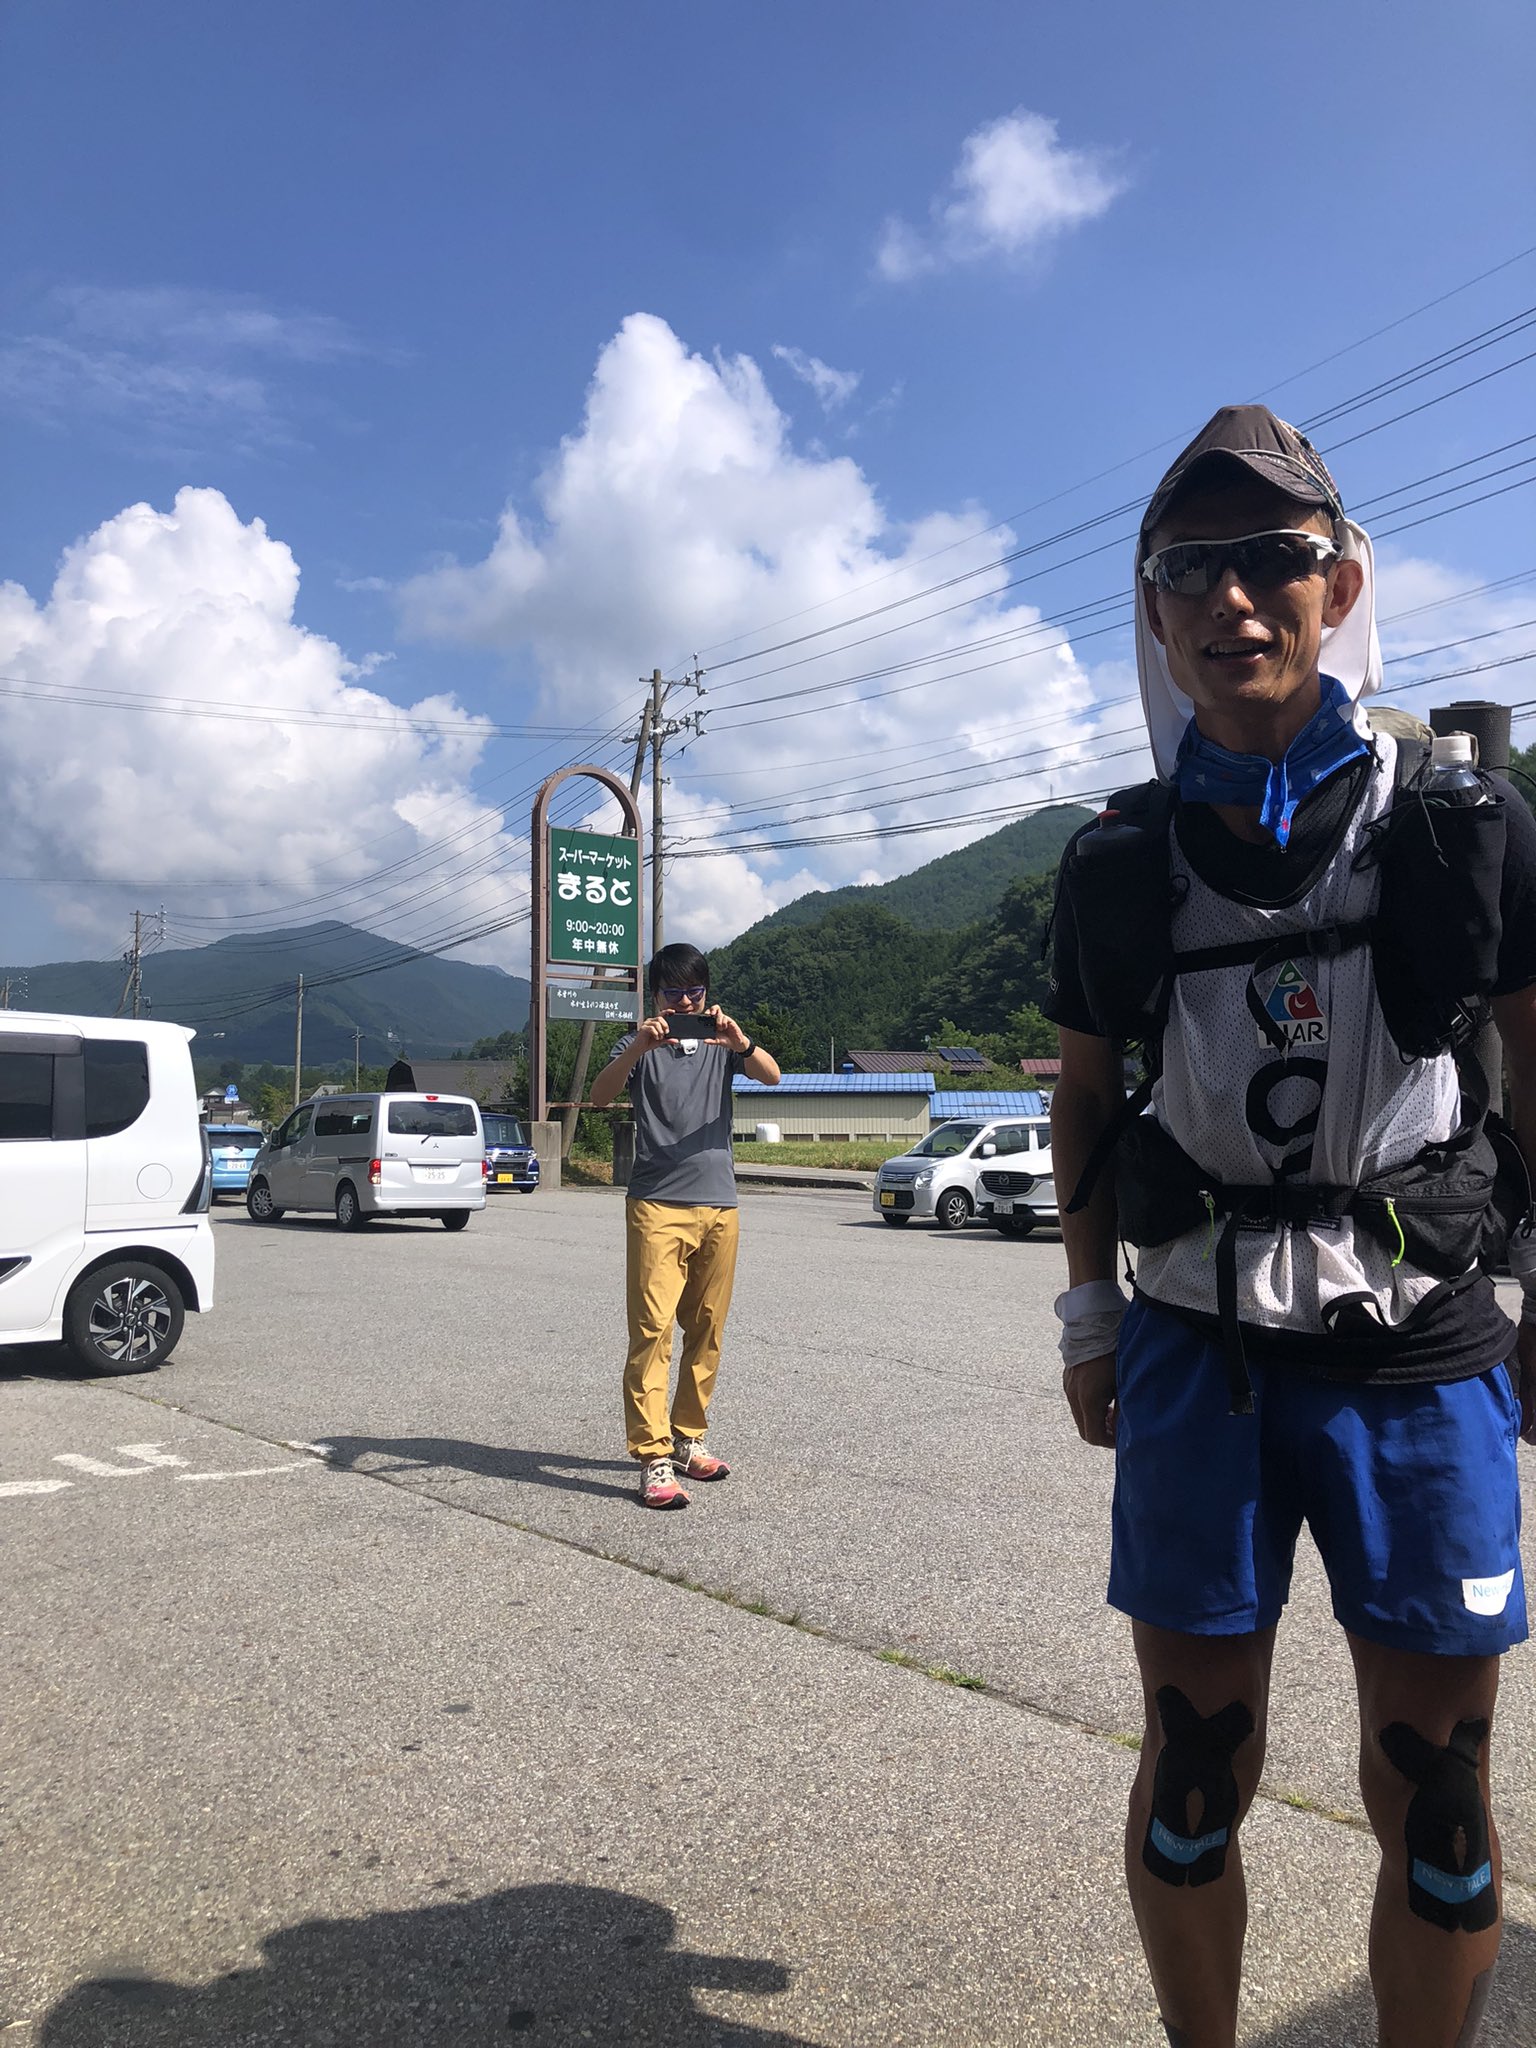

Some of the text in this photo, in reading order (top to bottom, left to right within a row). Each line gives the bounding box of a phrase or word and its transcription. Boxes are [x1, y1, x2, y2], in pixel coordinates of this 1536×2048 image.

[558, 847, 632, 869] スーパーマーケット
[557, 872, 632, 906] まると
[572, 937, 619, 955] 年中無休
